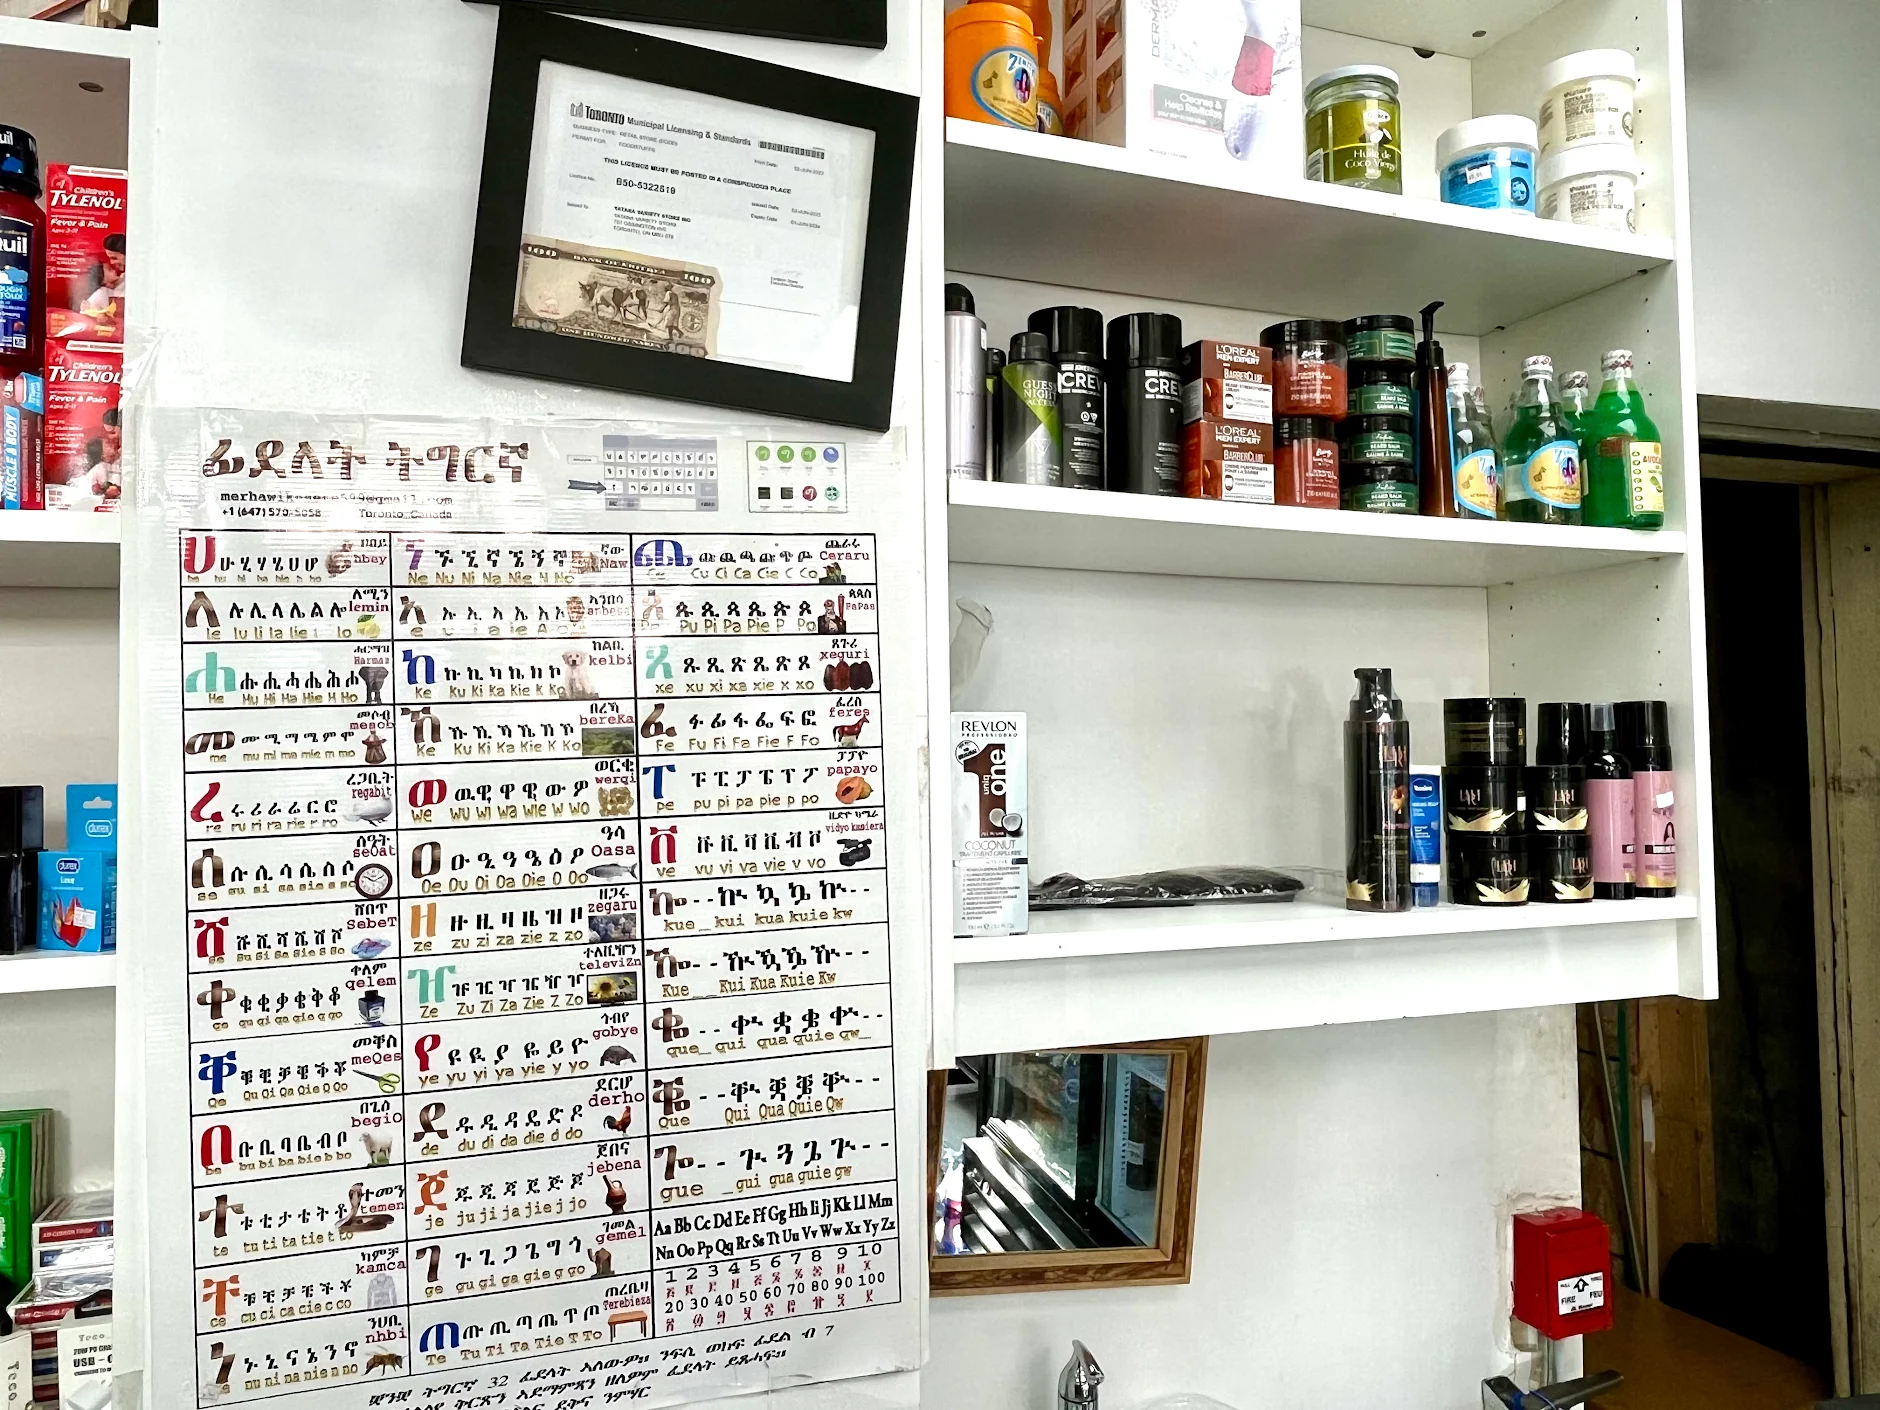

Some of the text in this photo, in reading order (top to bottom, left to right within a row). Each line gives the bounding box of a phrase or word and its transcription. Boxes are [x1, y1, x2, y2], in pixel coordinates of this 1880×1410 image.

[585, 106, 625, 125] TORONTO
[627, 117, 664, 130] Municipal
[667, 124, 703, 139] Licensing
[705, 131, 711, 139] &
[714, 132, 751, 146] Standards
[1345, 159, 1371, 169] Coco
[681, 170, 707, 180] POSTED
[770, 186, 791, 194] PLACE
[74, 187, 114, 196] Children's
[50, 190, 122, 209] TYLENOL
[527, 246, 557, 257] 100
[573, 255, 602, 264] BANK
[684, 273, 712, 285] 100
[73, 362, 112, 371] Children's
[1234, 356, 1260, 365] EXPERT
[48, 366, 121, 384] TYLENOL
[1145, 378, 1178, 395] CRE
[1234, 437, 1260, 445] EXPERT
[4, 412, 18, 502] MUSCLE BODY
[385, 441, 529, 483] ትግርኛ
[238, 507, 265, 517] (647)
[820, 550, 869, 561] Ceraru
[349, 601, 389, 612] lemin
[589, 655, 632, 665] kelbi
[819, 649, 870, 661] xeguri
[829, 707, 870, 717] feres
[350, 719, 394, 729] mesob
[961, 721, 1017, 732] REVLON
[827, 764, 877, 776] papayo
[982, 748, 1004, 796] uniq one
[595, 774, 636, 785] werqi
[352, 785, 392, 800] regabit
[965, 840, 1016, 851] COCONUT
[588, 899, 637, 915] zegaru
[346, 977, 396, 990] qelem
[592, 1025, 638, 1039] gobye
[351, 1052, 402, 1065] meQes
[588, 1091, 645, 1108] derho
[588, 1158, 641, 1177] jebena
[361, 1202, 405, 1214] temen
[654, 1192, 893, 1237] Aa Bb Cc Dd Ee Ff Gg Hh Ii Jj Kk Ll Mm
[595, 1226, 646, 1245] gemel
[656, 1216, 896, 1261] Nn Oo Pp Qq Rr Ss Tt Uu Vv Ww Xx Yy Zz
[356, 1260, 406, 1275] kamca
[665, 1243, 882, 1283] 1 2 3 4 5 6 7 8 9 10
[665, 1272, 885, 1314] 20 30 40 50 60 70 80 90 100
[603, 1296, 651, 1311] Terebieza
[1561, 1296, 1576, 1304] FIRE
[365, 1328, 406, 1344] nhbi
[73, 1357, 95, 1368] USB
[488, 1376, 508, 1389] 32
[825, 1325, 834, 1336] 7
